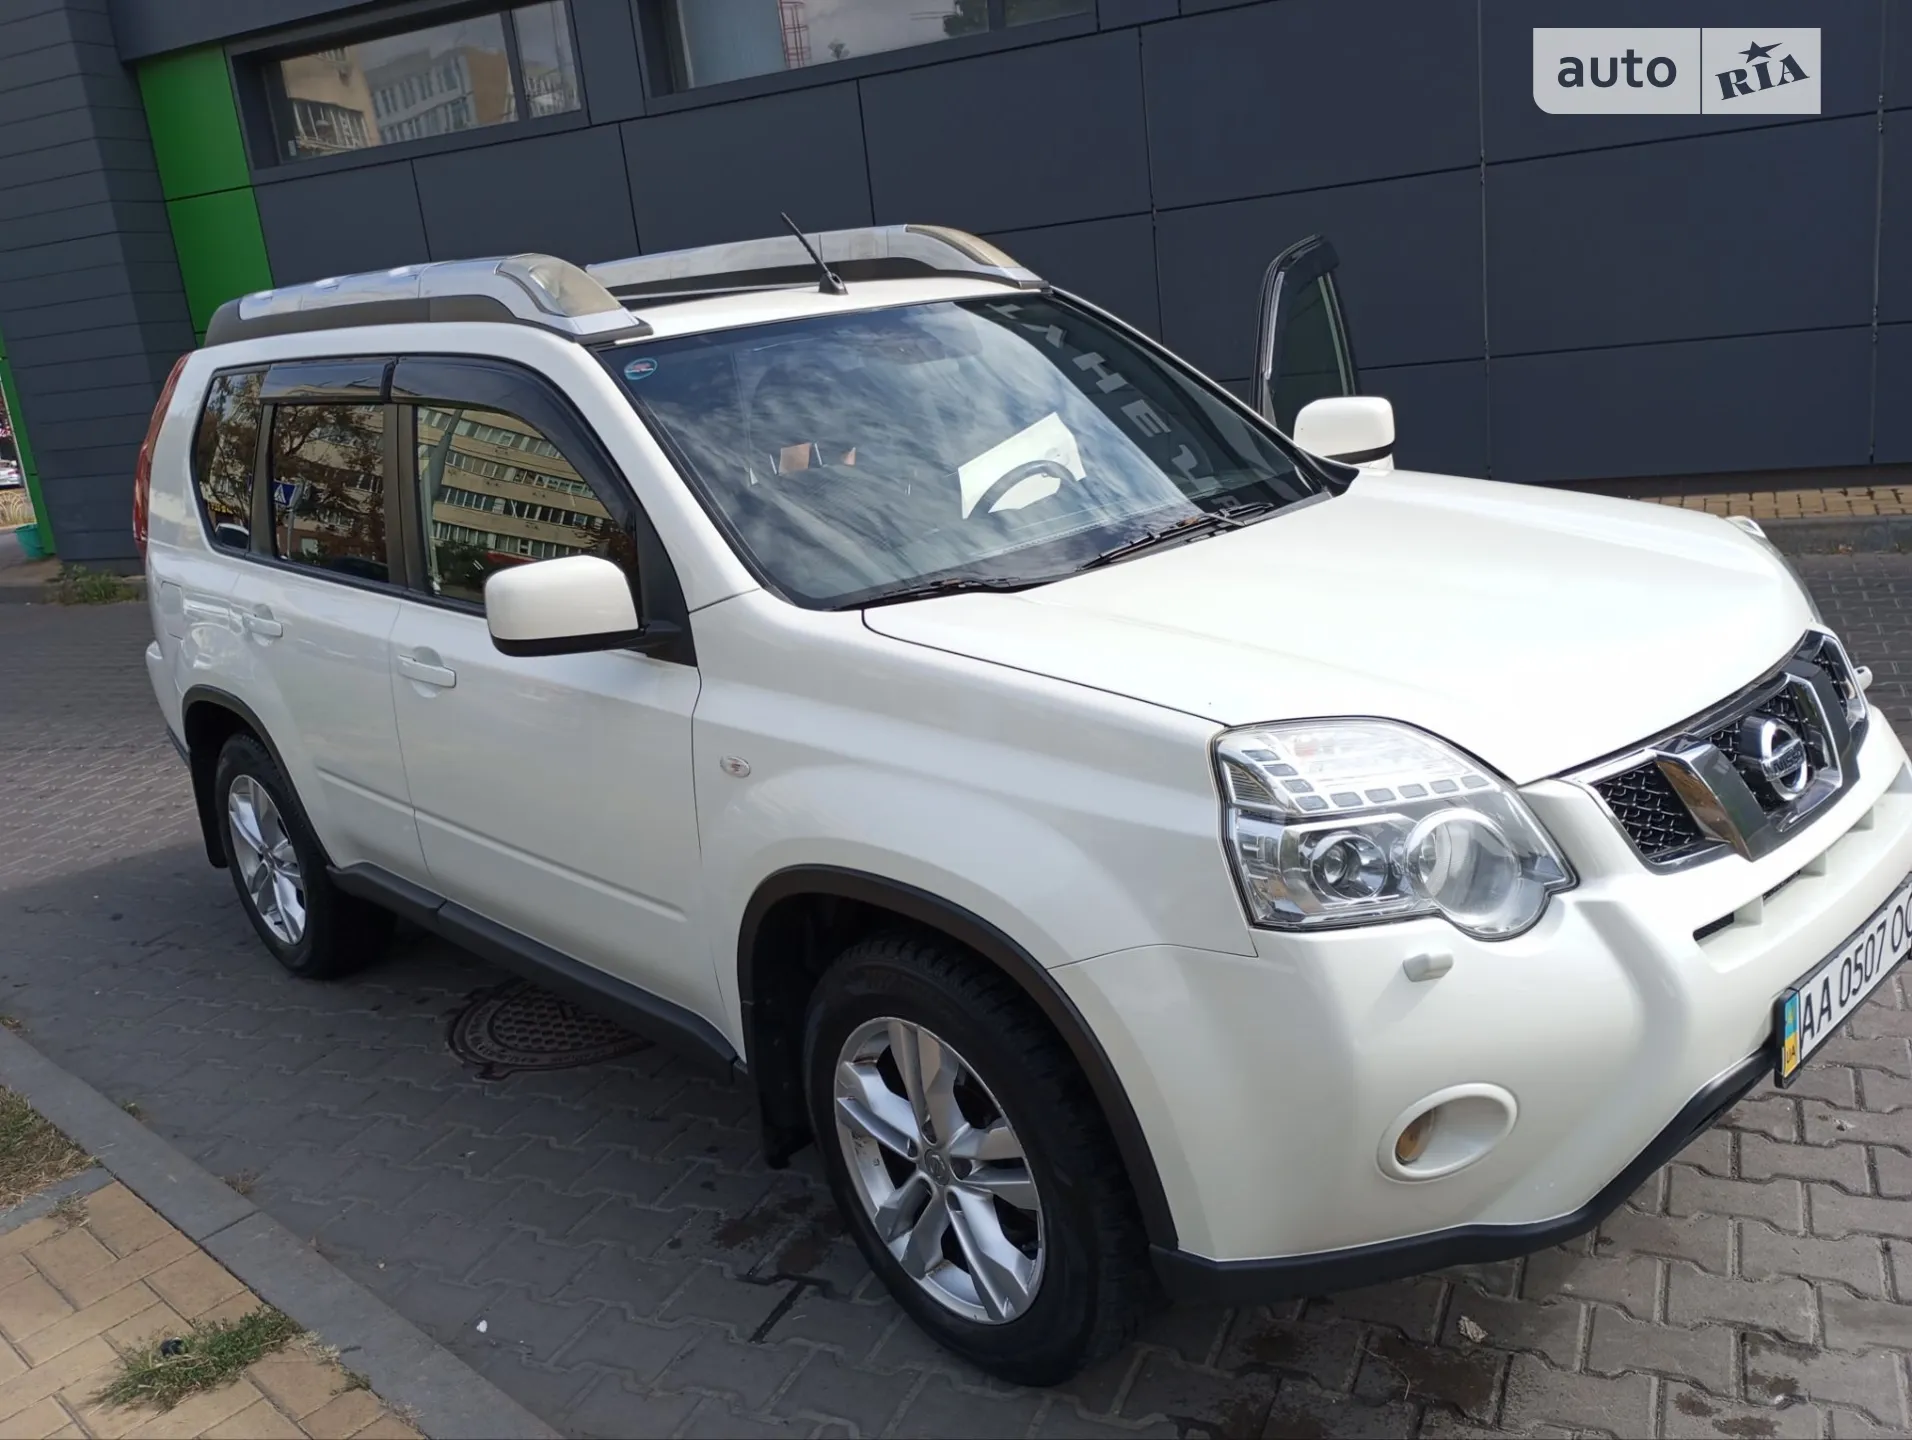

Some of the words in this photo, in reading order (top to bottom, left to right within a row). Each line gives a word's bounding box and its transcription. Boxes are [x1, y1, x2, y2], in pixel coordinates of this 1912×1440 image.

[1801, 976, 1832, 1048] AA
[1839, 918, 1887, 1008] 0507
[1786, 1044, 1796, 1064] UA
